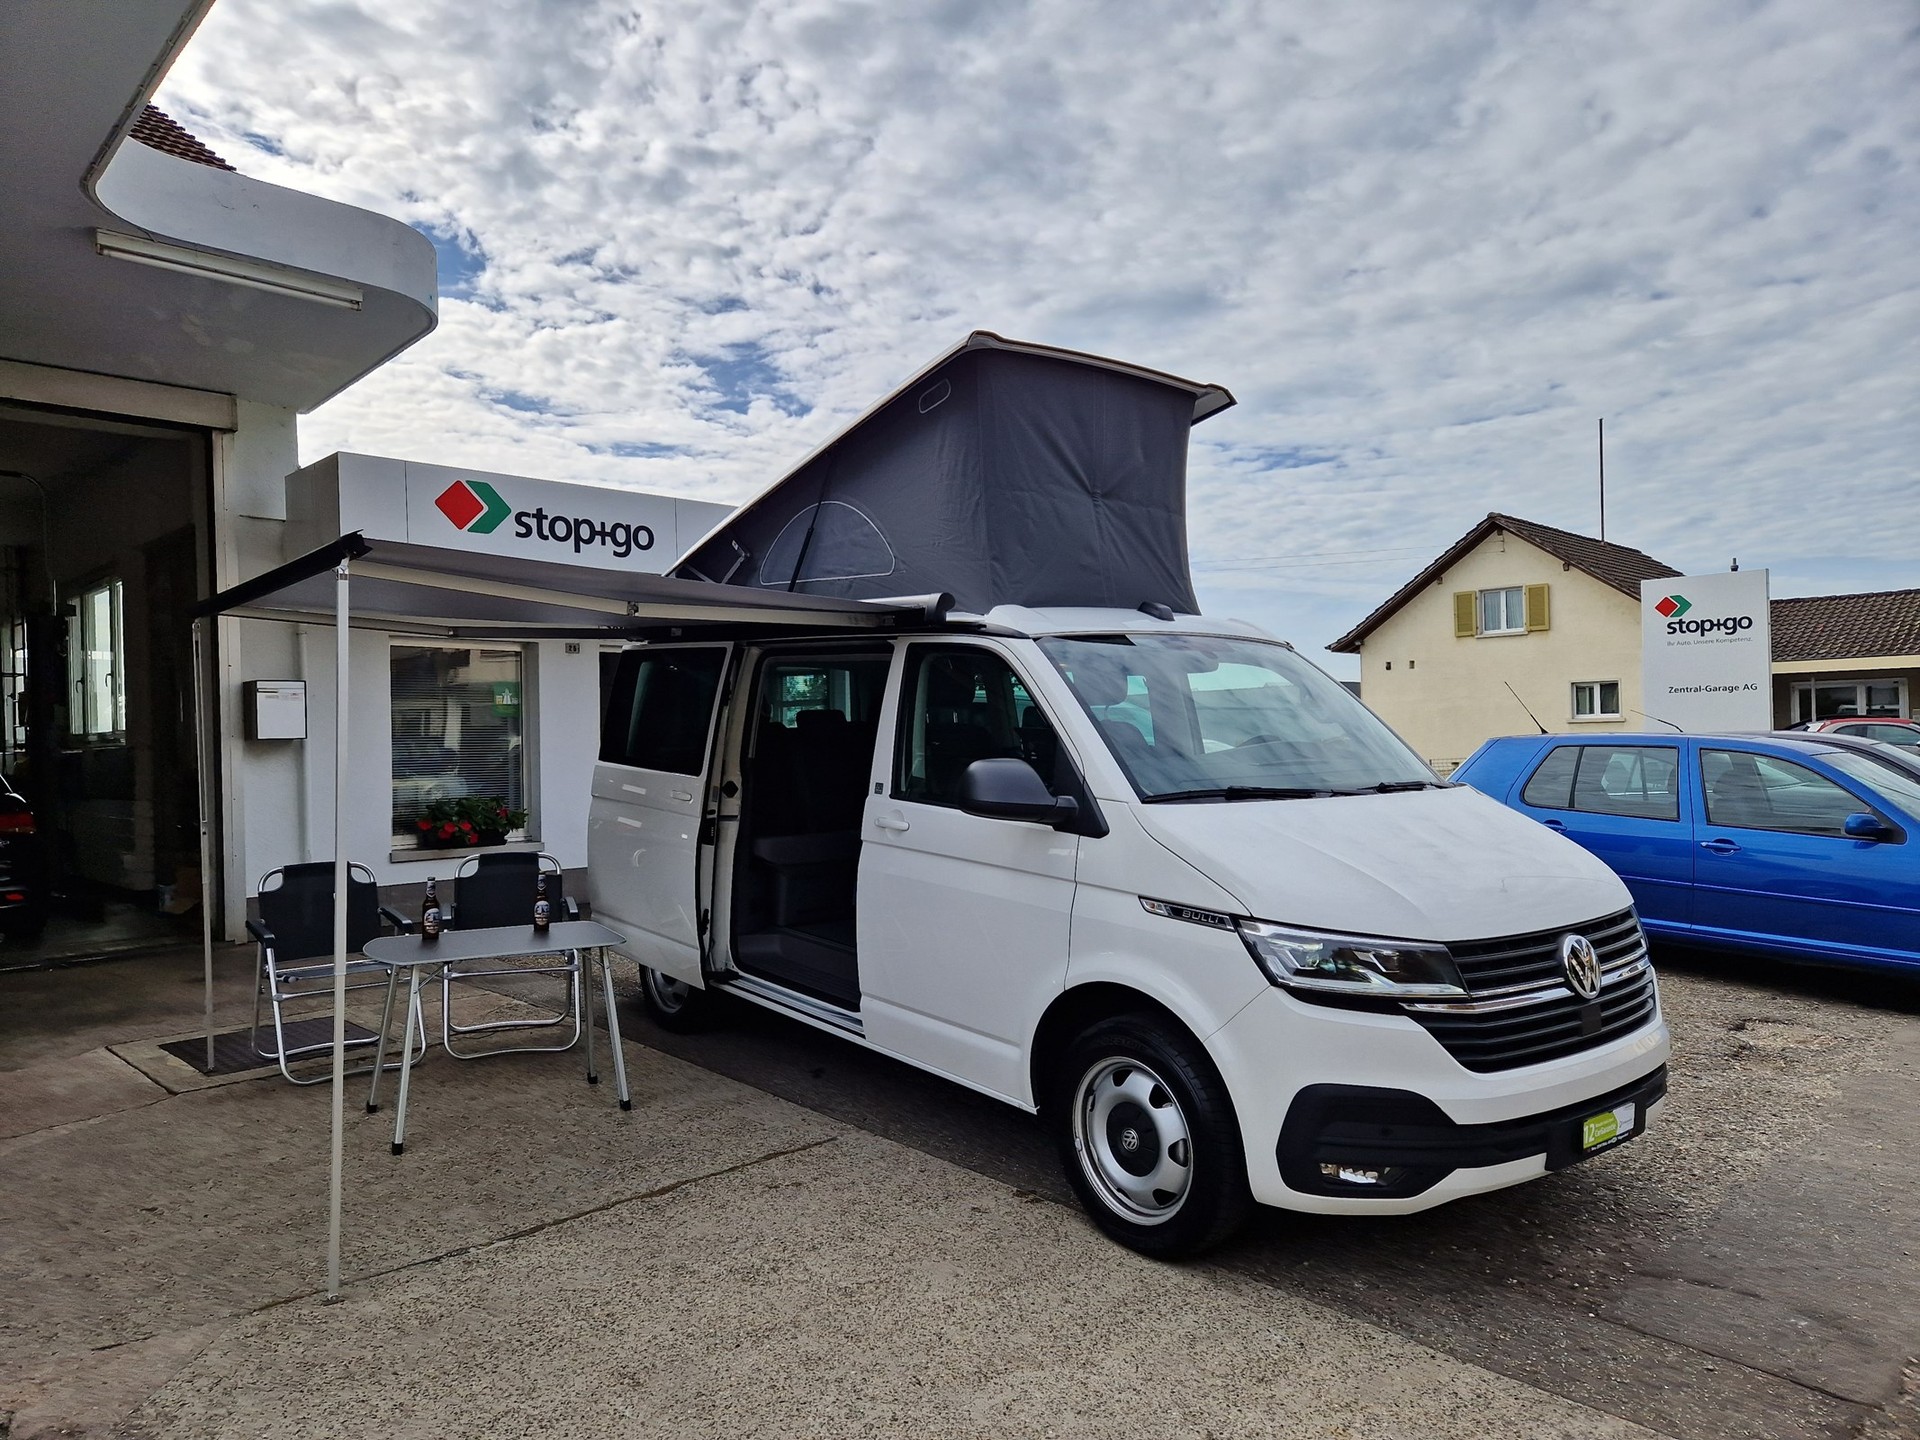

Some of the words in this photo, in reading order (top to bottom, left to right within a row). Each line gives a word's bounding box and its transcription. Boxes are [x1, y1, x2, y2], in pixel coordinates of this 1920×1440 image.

[514, 507, 655, 557] stop+go
[1667, 616, 1753, 637] stop+go
[1668, 684, 1740, 694] Zentral-Garage
[1742, 683, 1758, 691] AG
[1182, 909, 1219, 924] BULLI
[1584, 1123, 1595, 1143] 12
